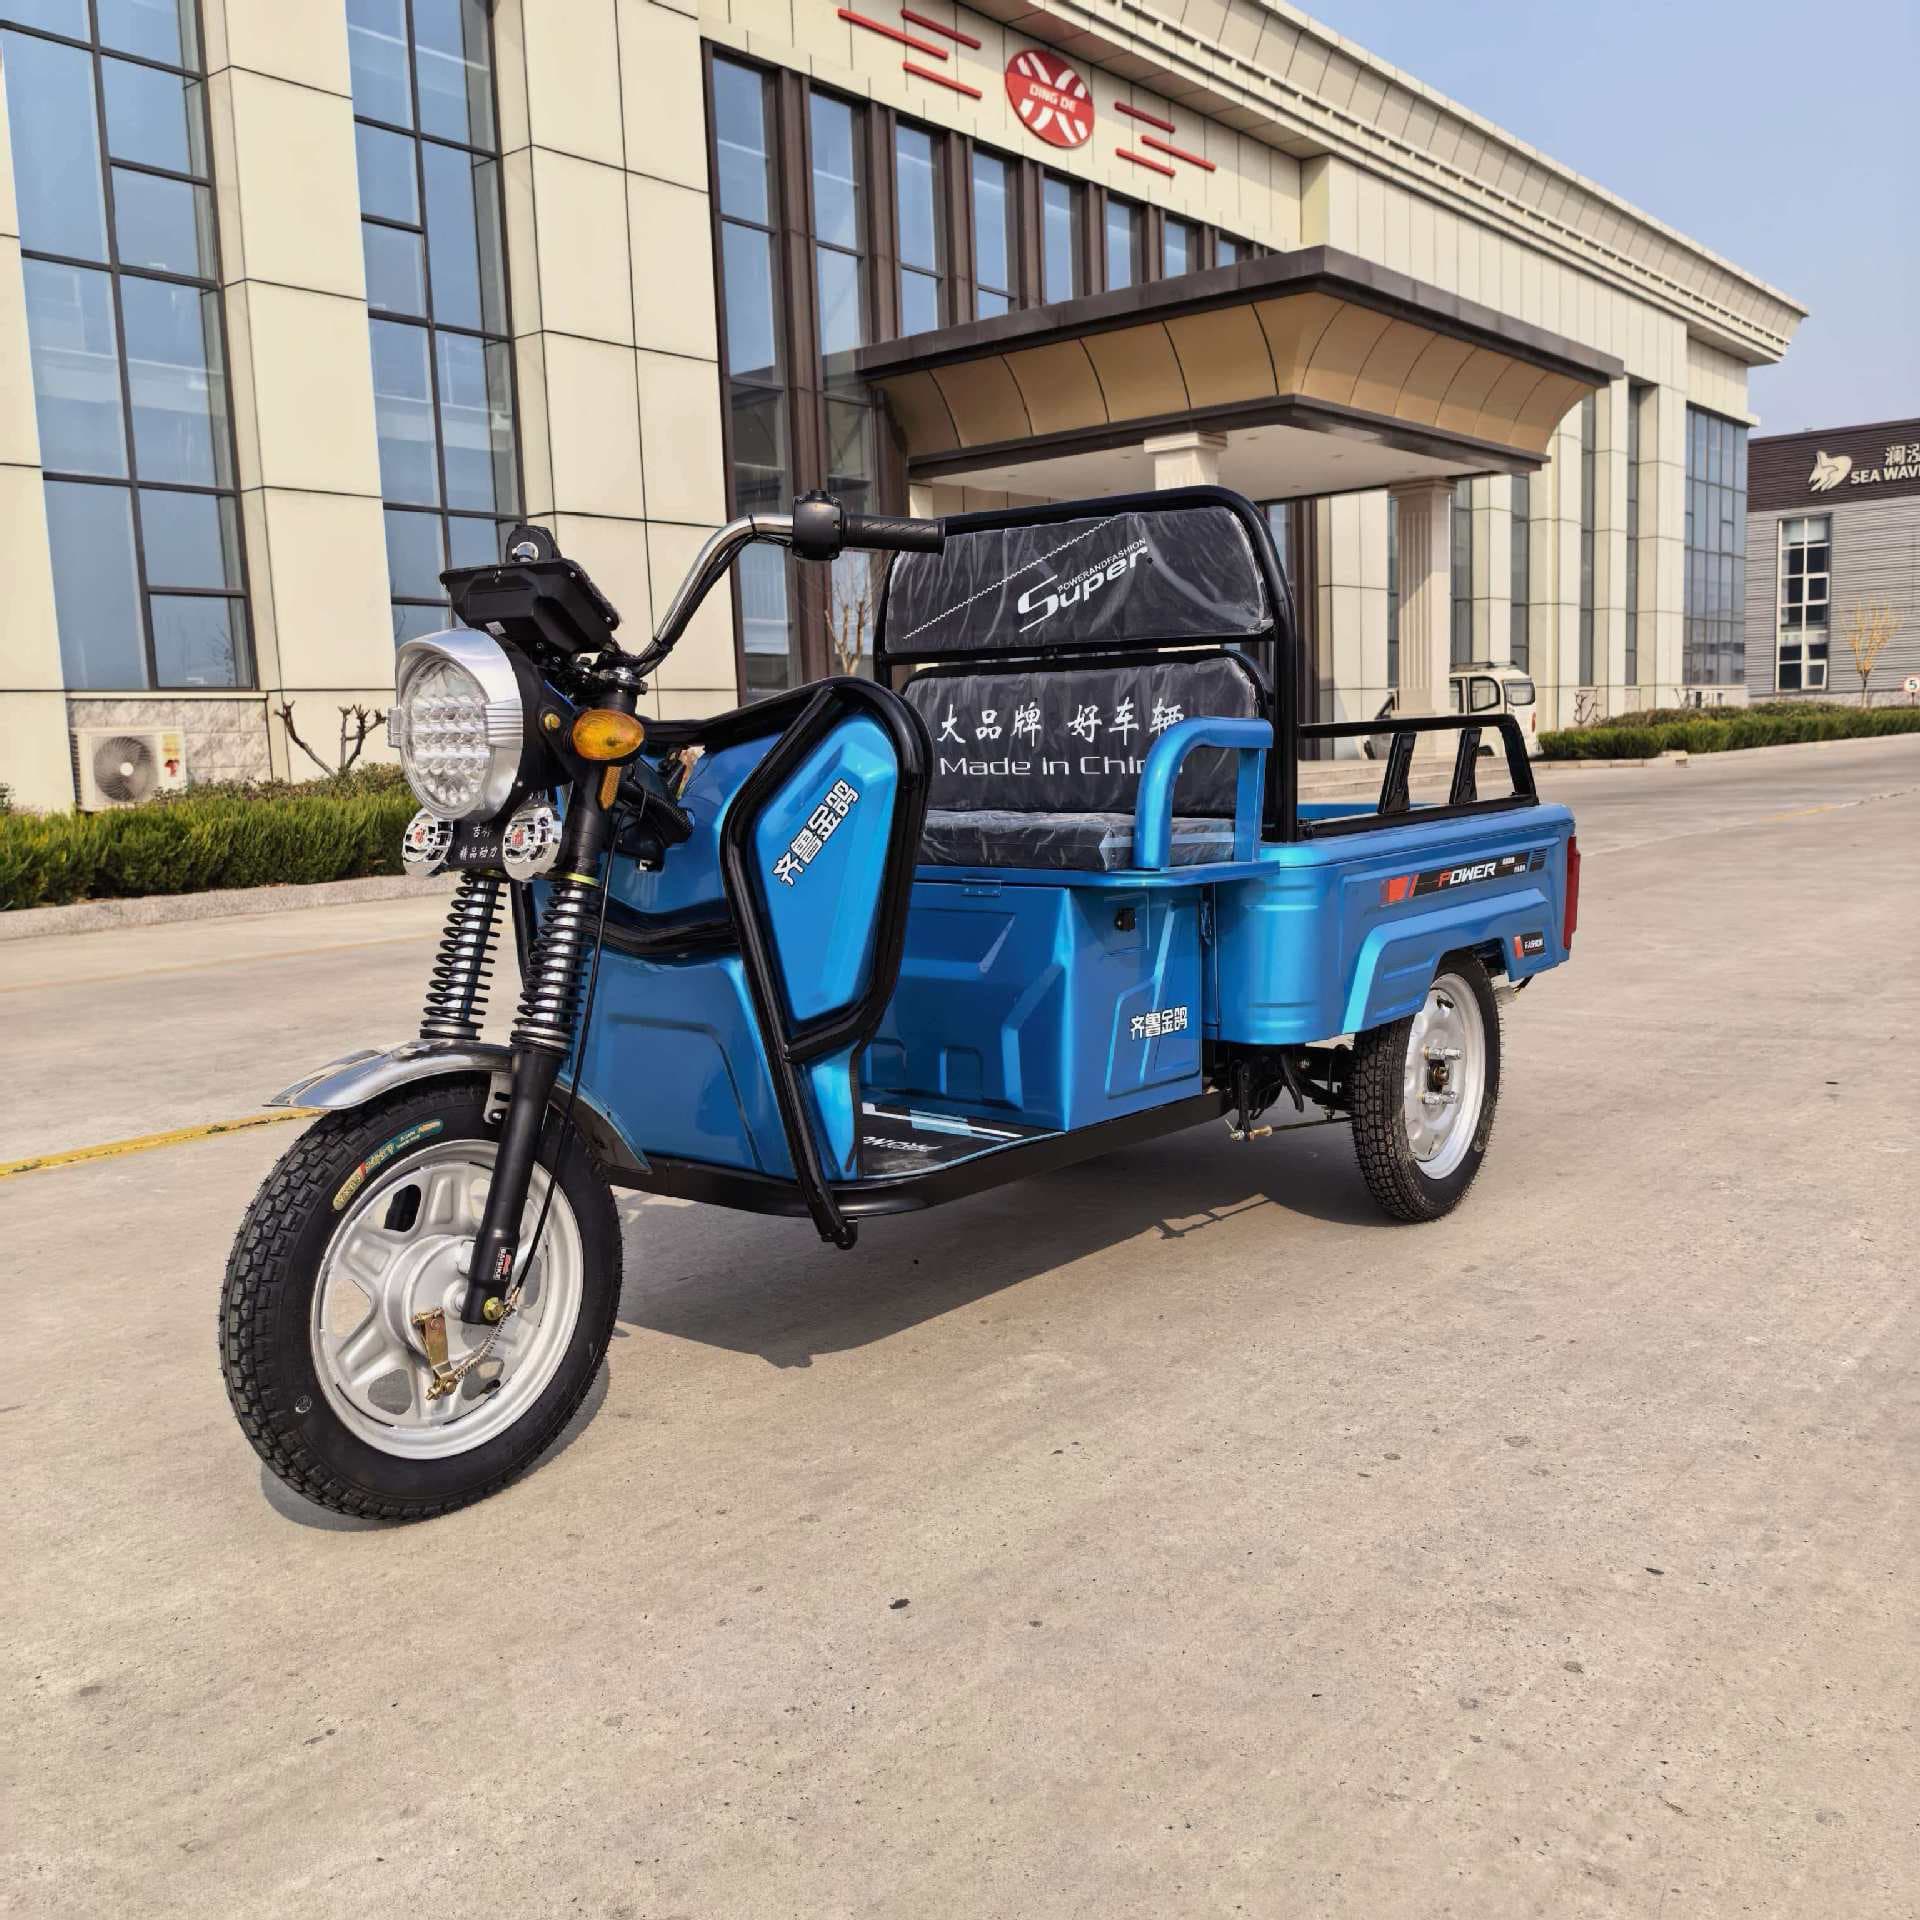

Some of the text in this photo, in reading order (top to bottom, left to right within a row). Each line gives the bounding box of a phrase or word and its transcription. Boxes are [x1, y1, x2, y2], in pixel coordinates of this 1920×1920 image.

[1850, 464, 1920, 484] SEA WAV
[1057, 537, 1147, 592] POWERANDFASHION
[1018, 545, 1148, 633] Super
[937, 702, 1042, 748] 大品牌
[939, 756, 1031, 776] Made
[1437, 862, 1498, 888] POWER
